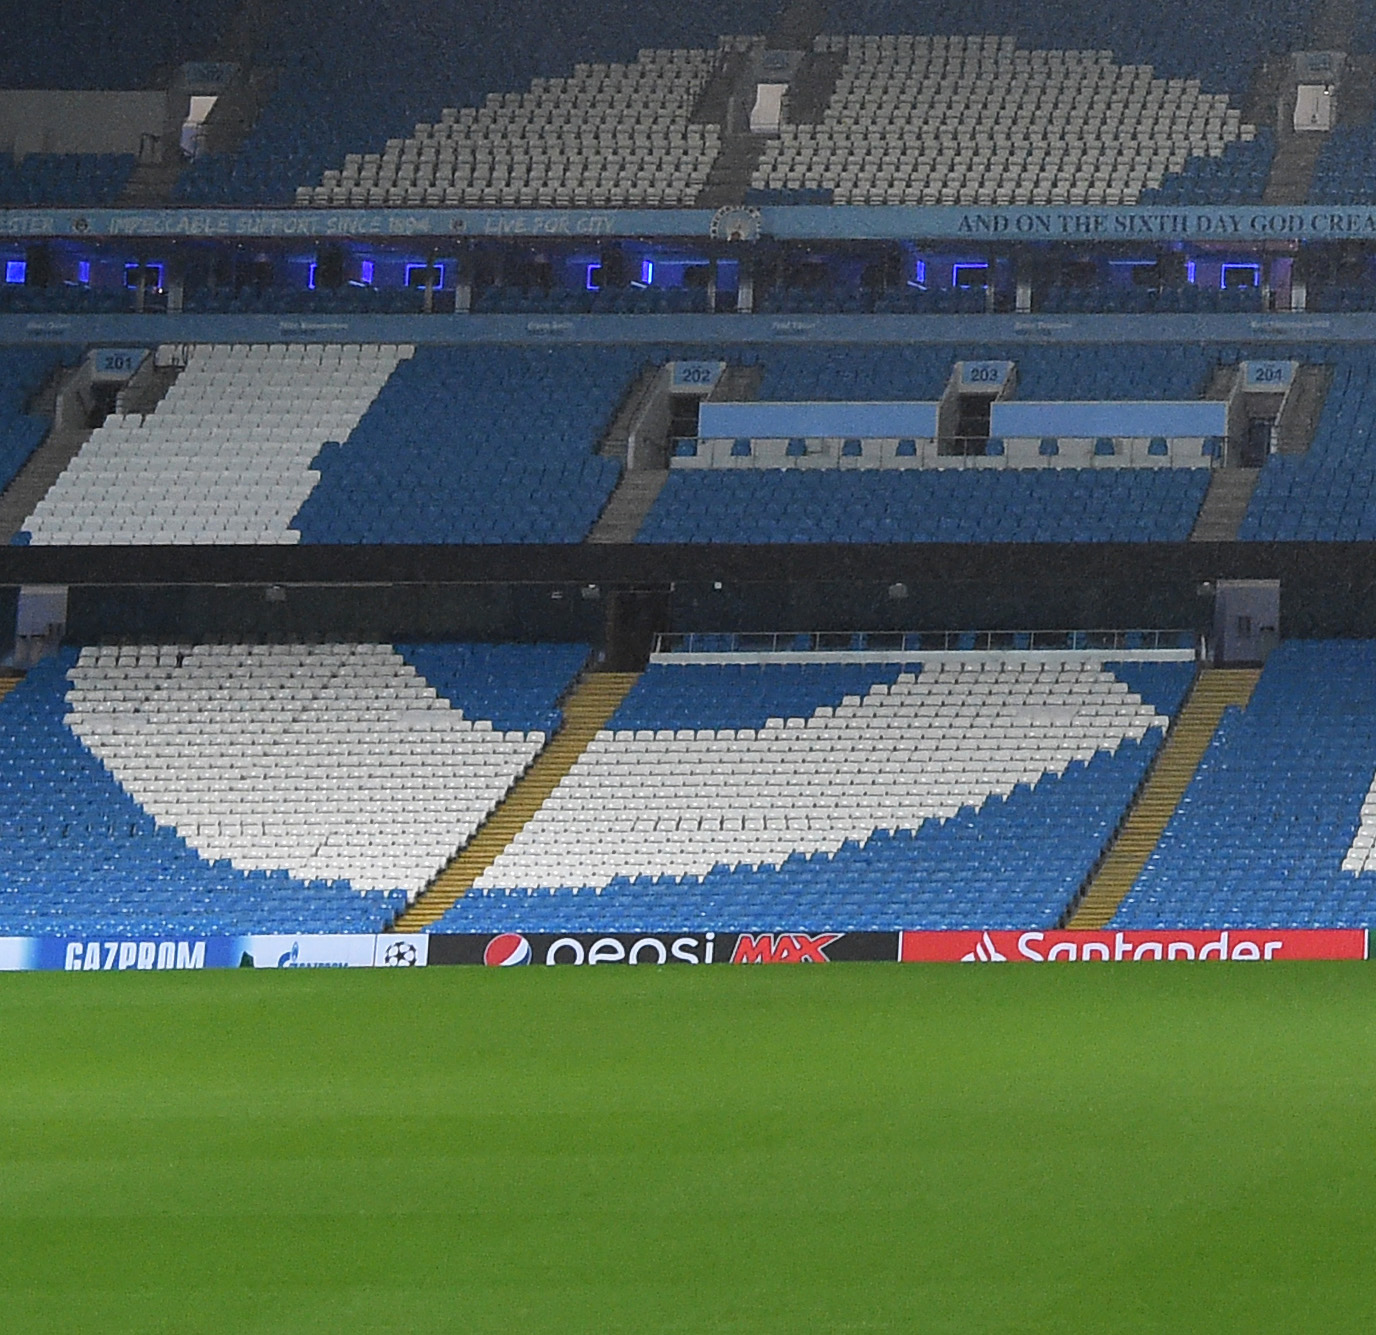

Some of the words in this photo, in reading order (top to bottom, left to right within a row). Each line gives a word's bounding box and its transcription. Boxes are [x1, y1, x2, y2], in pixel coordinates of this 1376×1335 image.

[957, 213, 1010, 233] AND
[1015, 213, 1051, 233] ON
[1057, 213, 1108, 233] THE
[1114, 213, 1188, 233] SIXTH
[1195, 214, 1244, 232] DAY
[1249, 214, 1305, 232] GOD
[104, 356, 133, 371] 201
[682, 368, 710, 382] 202
[970, 368, 999, 383] 203
[65, 941, 208, 970] GAZPROM
[546, 932, 717, 965] pepsi
[730, 932, 847, 964] MAX
[1017, 931, 1284, 962] Santander
